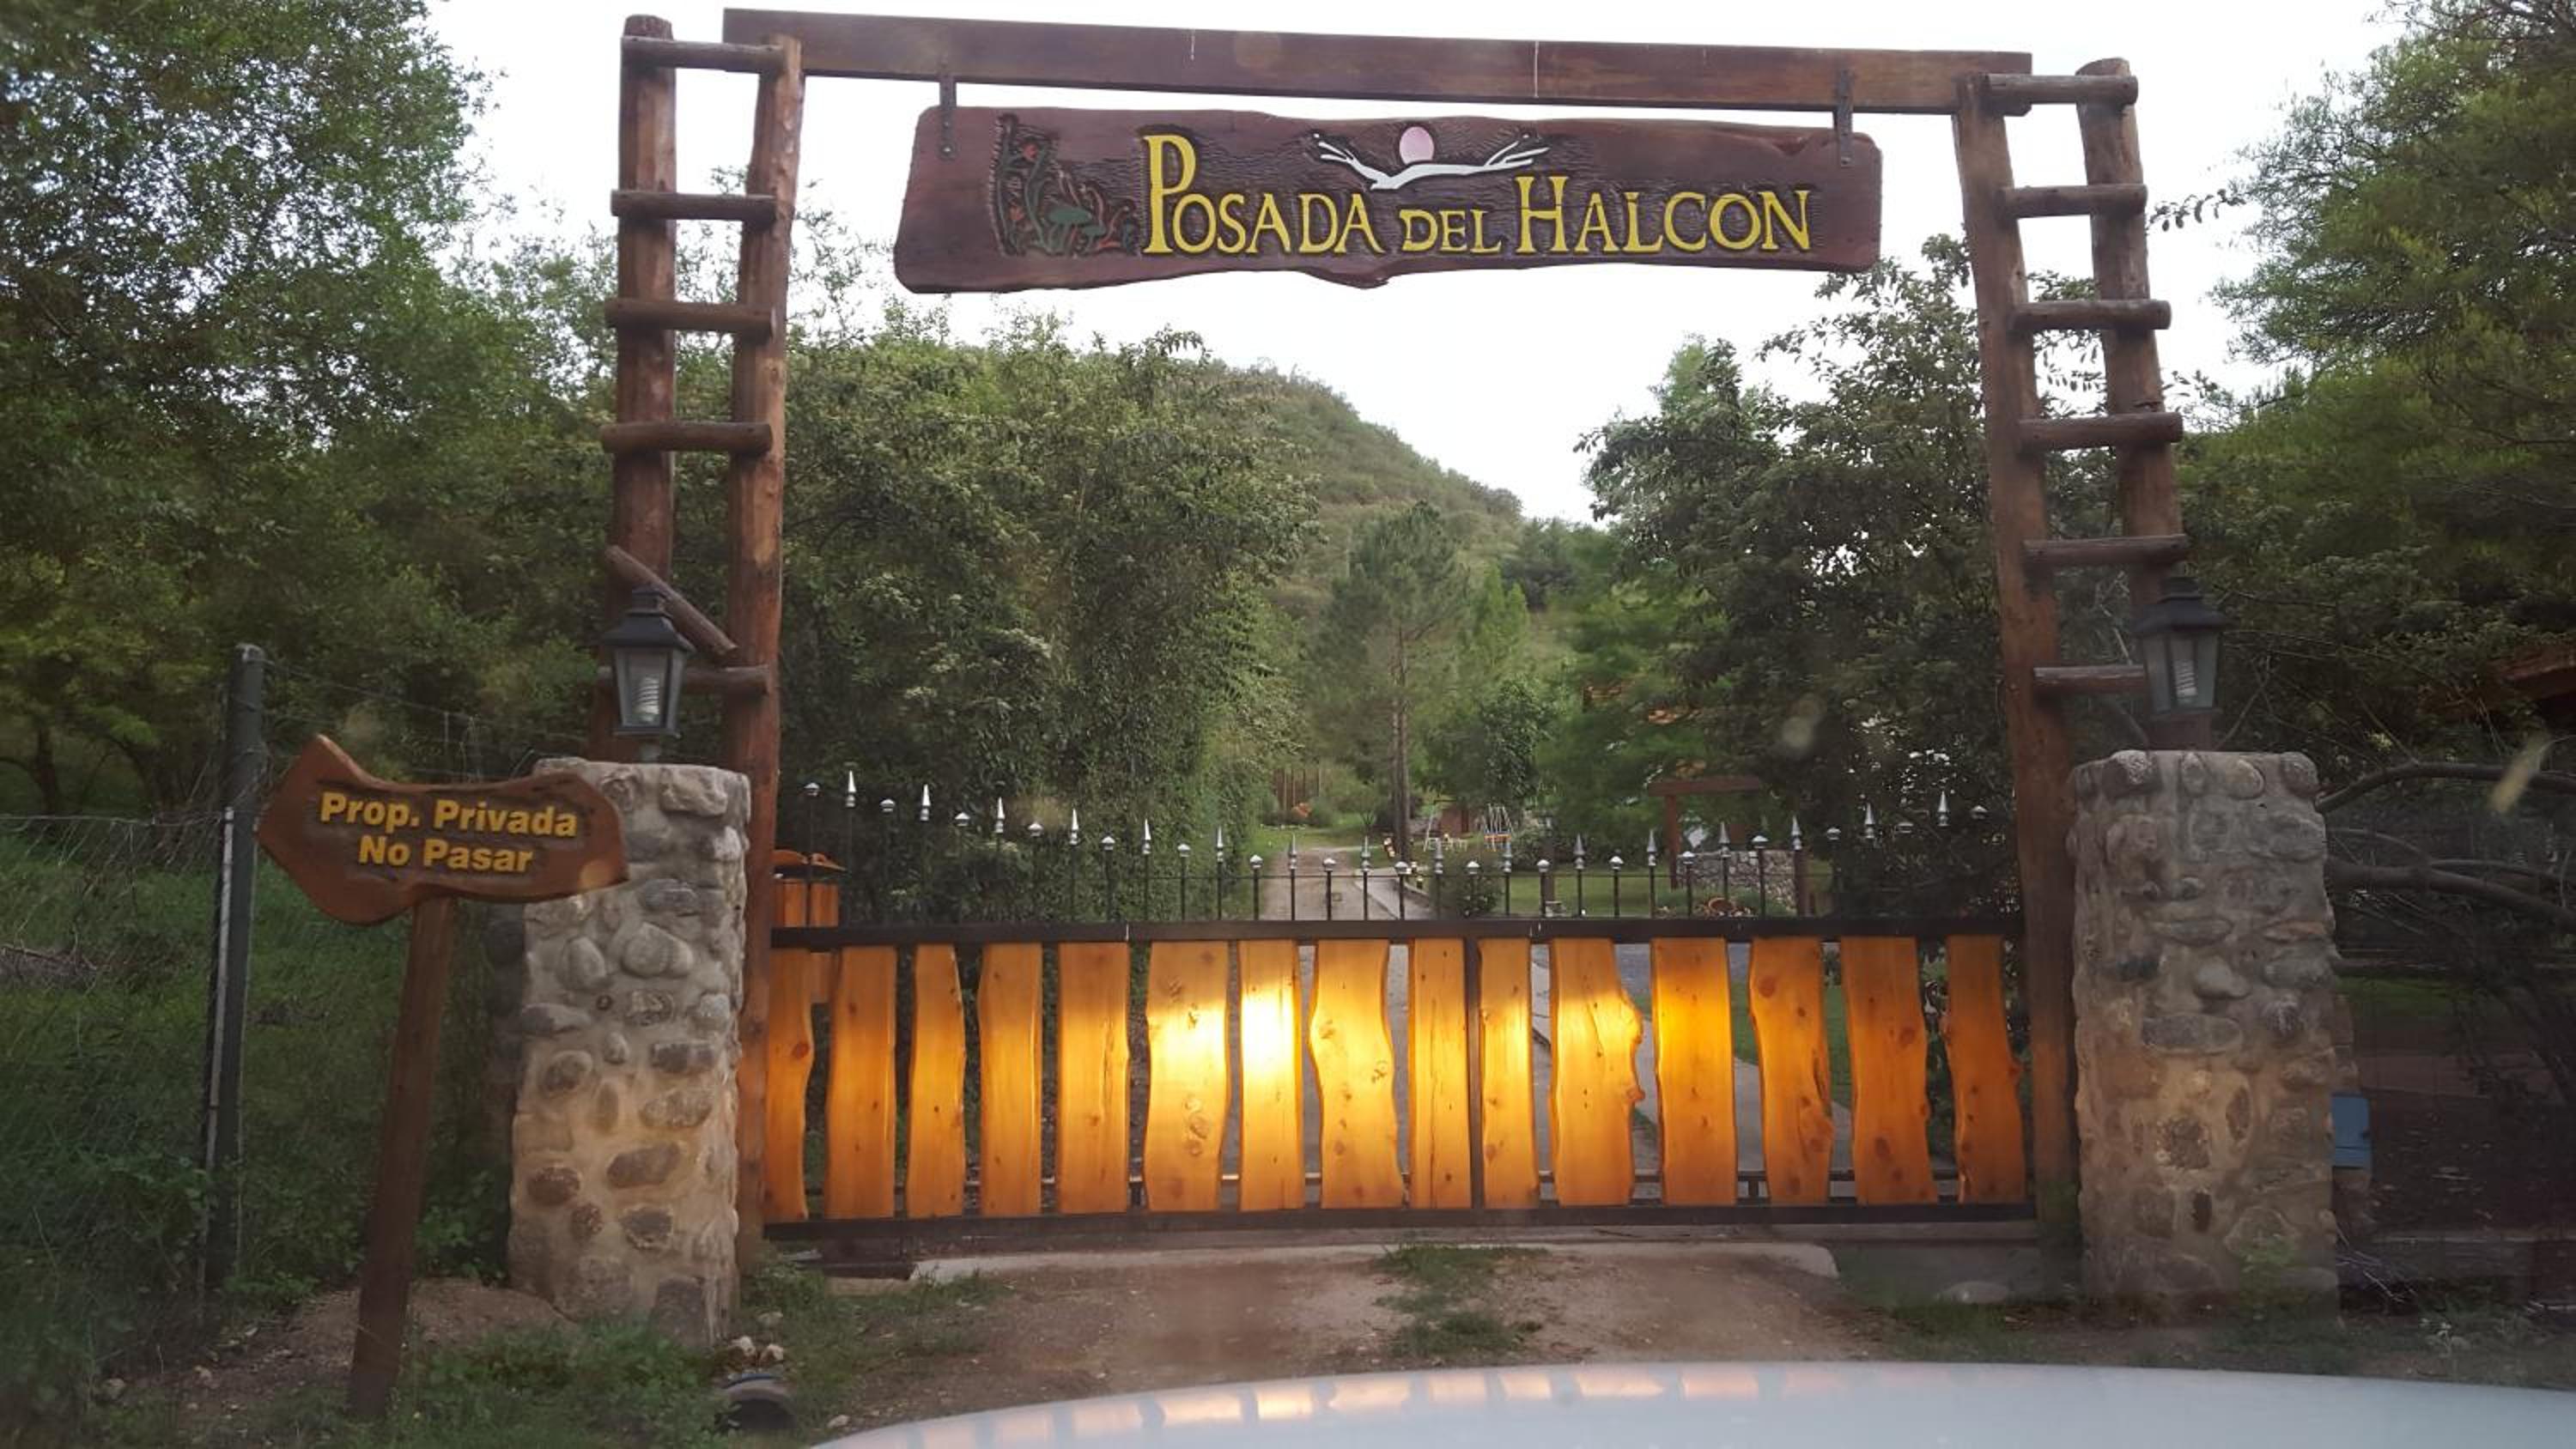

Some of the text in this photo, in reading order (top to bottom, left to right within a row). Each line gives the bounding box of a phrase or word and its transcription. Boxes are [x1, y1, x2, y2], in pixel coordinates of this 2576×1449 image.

[1143, 134, 1811, 253] POSADA DEL HALCON
[320, 791, 578, 837] Prop. Privada
[358, 835, 535, 872] No Pasar
